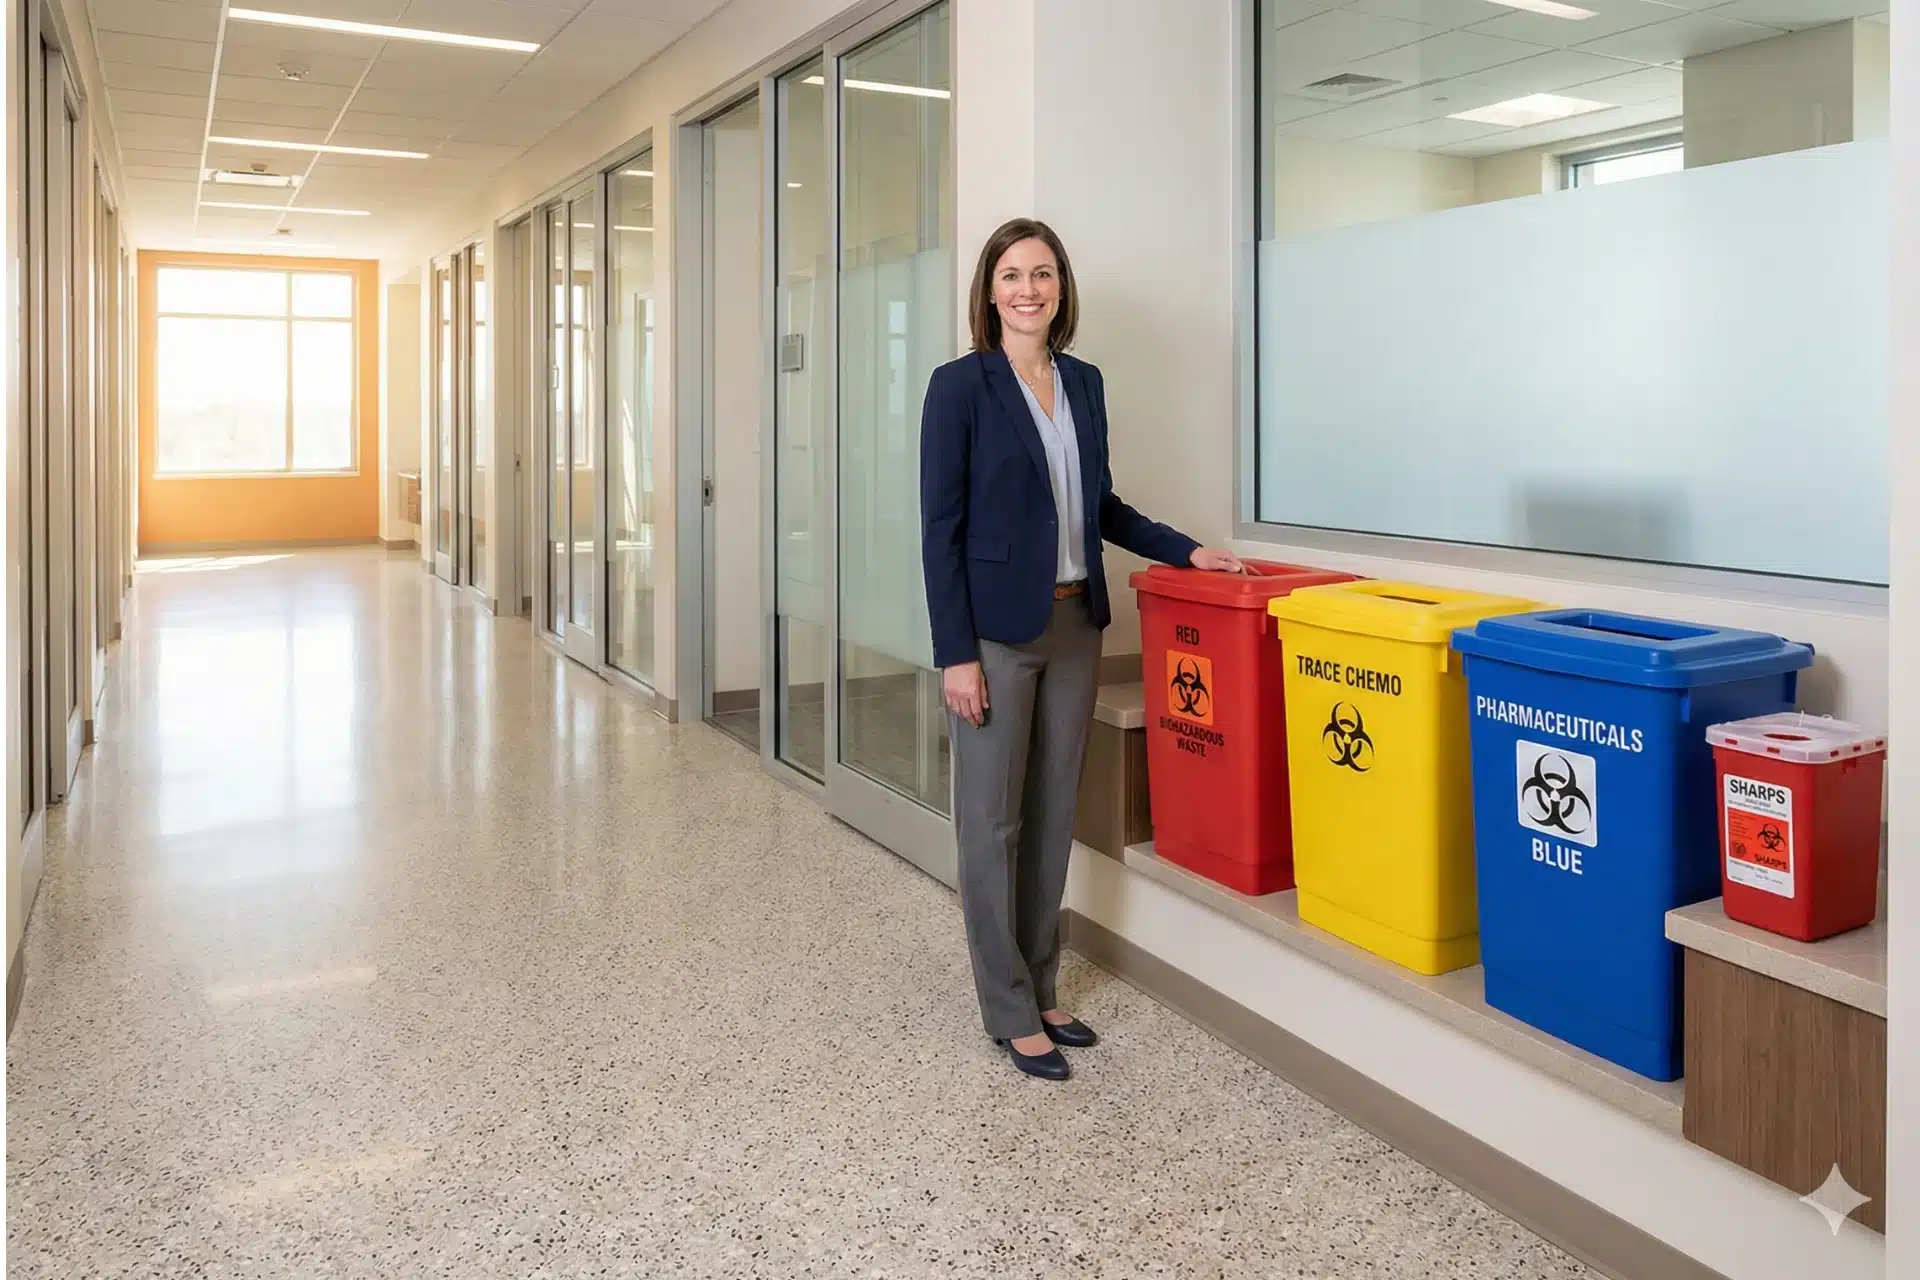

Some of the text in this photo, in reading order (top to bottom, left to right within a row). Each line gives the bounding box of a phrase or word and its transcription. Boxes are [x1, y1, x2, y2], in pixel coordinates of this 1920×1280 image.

[1176, 624, 1200, 645] RED
[1296, 654, 1402, 696] TRACE CHEMO
[1476, 695, 1643, 753] PHARMACEUTICALS
[1176, 736, 1207, 758] WASTE
[1729, 779, 1786, 805] SHARPS
[1532, 837, 1583, 875] BLUE
